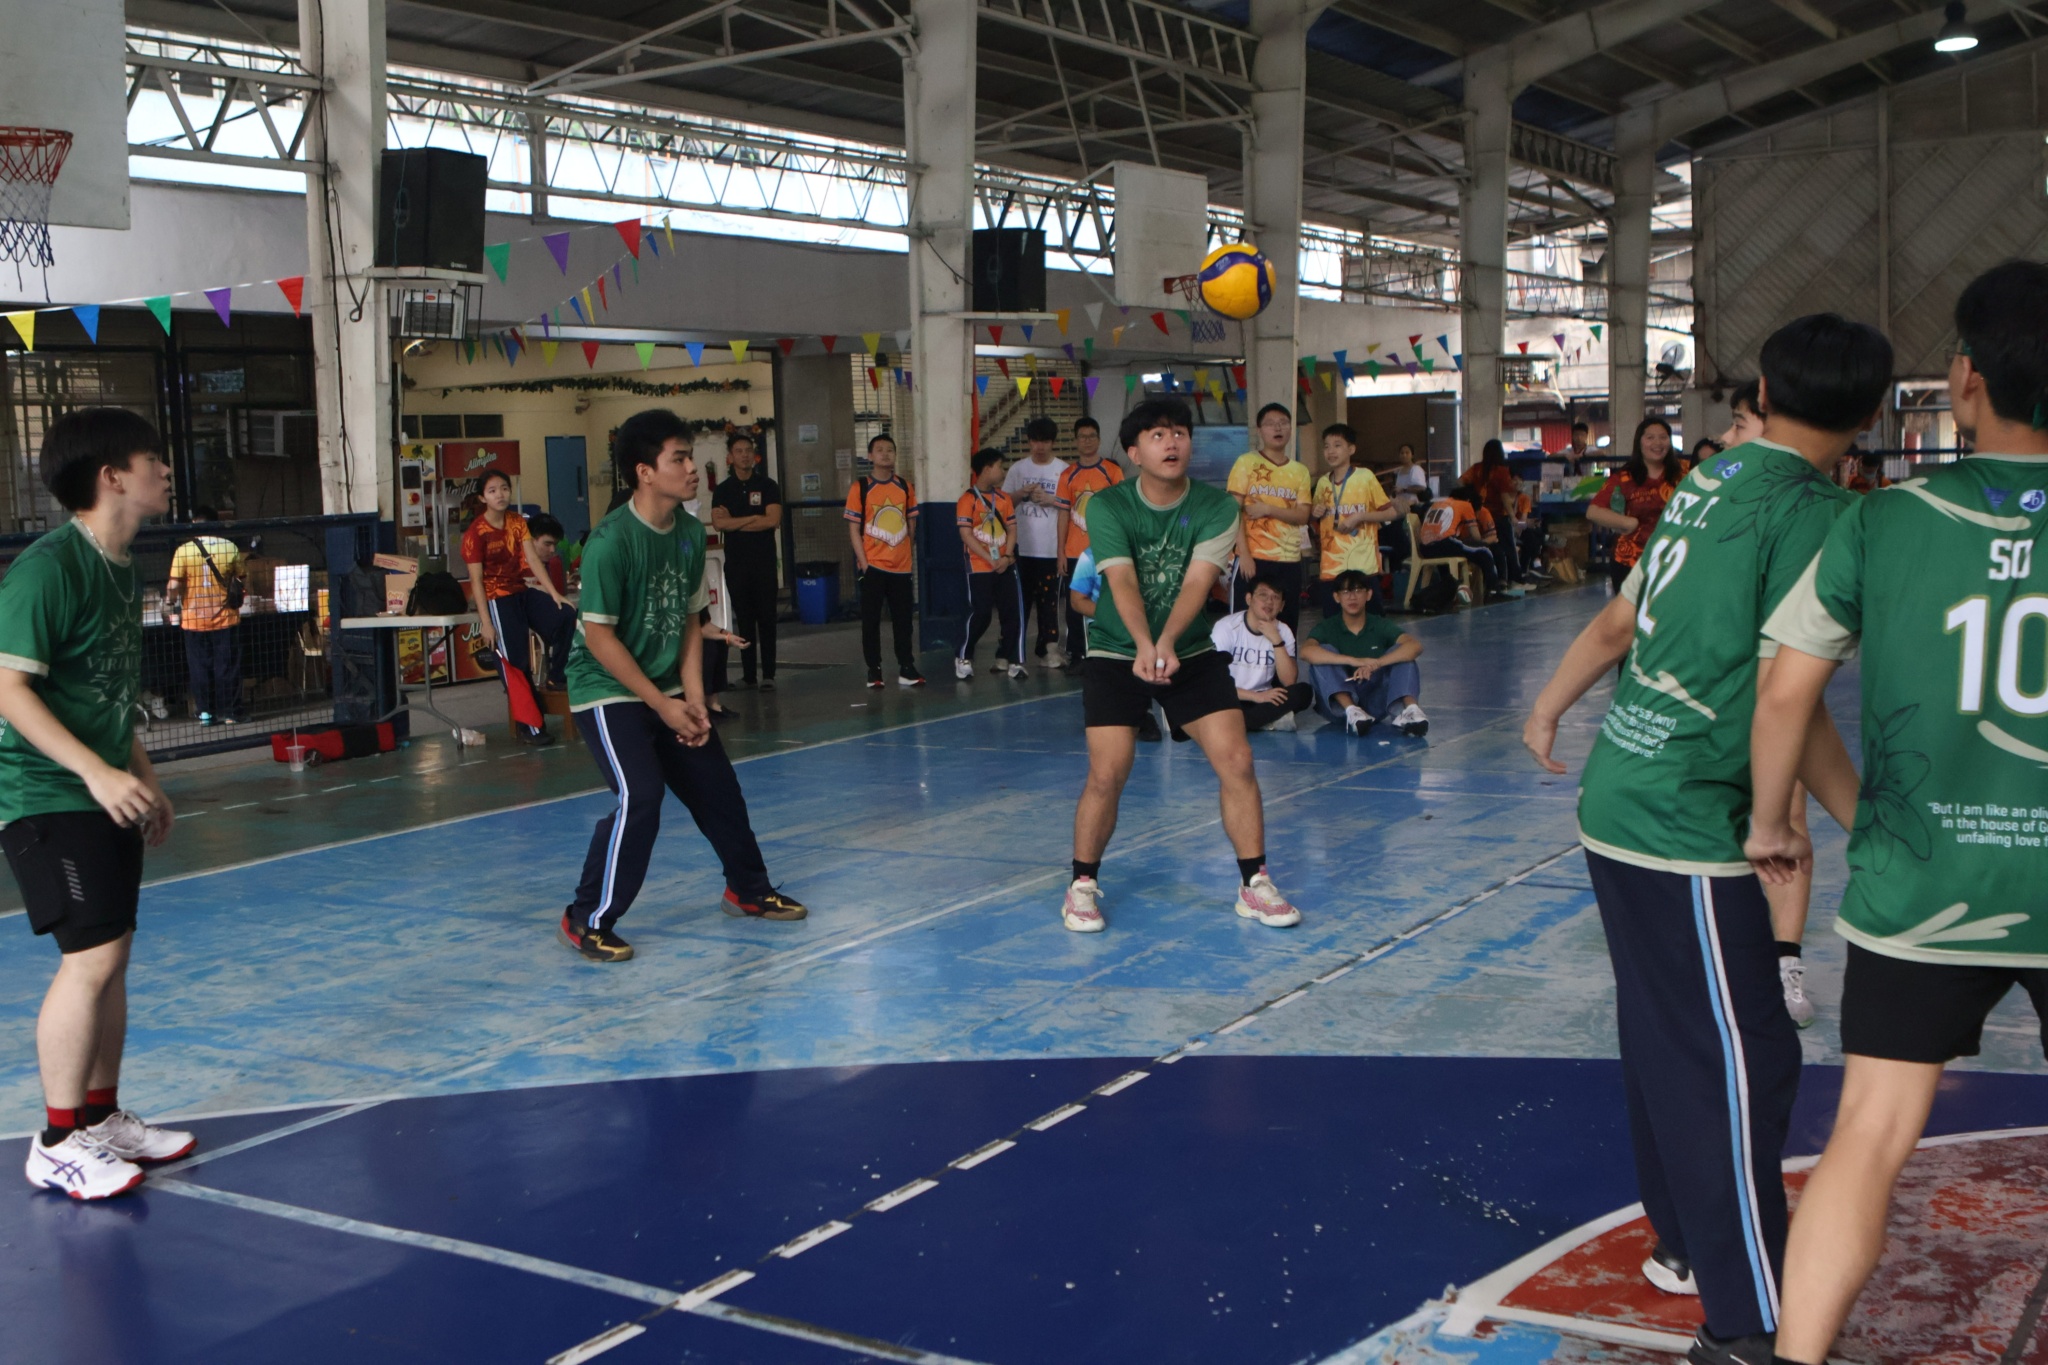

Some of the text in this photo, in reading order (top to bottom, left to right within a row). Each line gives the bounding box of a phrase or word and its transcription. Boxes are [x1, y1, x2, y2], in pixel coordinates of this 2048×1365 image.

[1988, 539, 2034, 581] SO
[1232, 646, 1275, 666] HCHS
[1945, 596, 2048, 717] 10
[1955, 803, 1960, 815] I
[1963, 804, 1982, 816] am
[1985, 803, 2008, 817] like
[2011, 807, 2027, 818] an
[1942, 816, 2048, 833] in the house of G
[1956, 831, 2012, 848] unfailing
[2015, 833, 2041, 847] love
